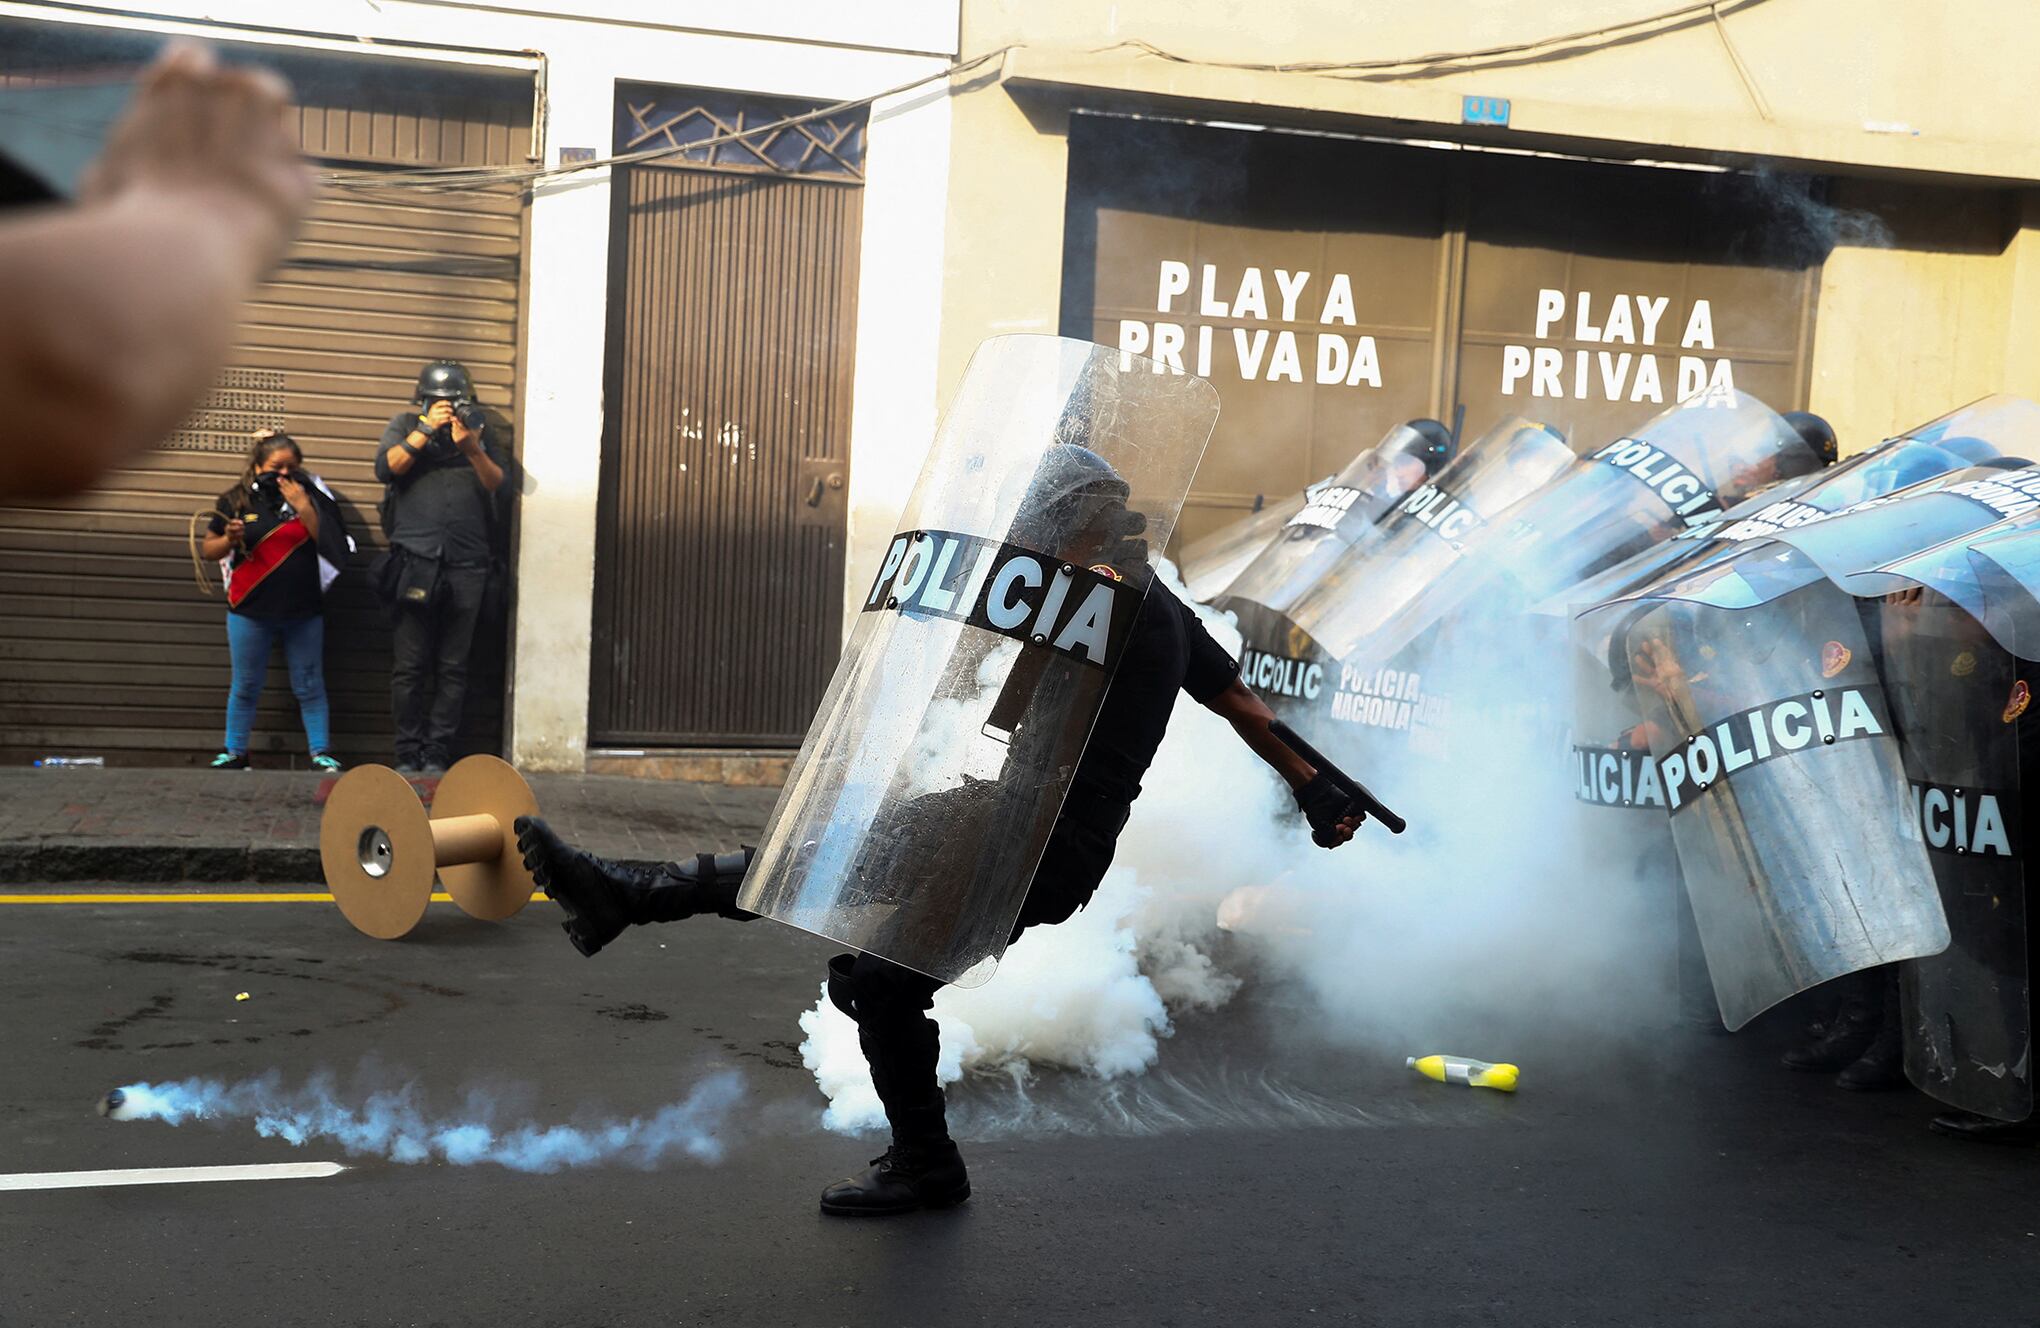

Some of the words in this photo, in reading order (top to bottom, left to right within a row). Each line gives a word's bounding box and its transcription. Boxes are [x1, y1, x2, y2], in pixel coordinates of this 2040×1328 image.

[1118, 319, 1382, 388] PRIVADA
[1501, 345, 1737, 409] PRIVADA
[868, 536, 1116, 666] POLICIA
[1661, 690, 1883, 809] POLICIA
